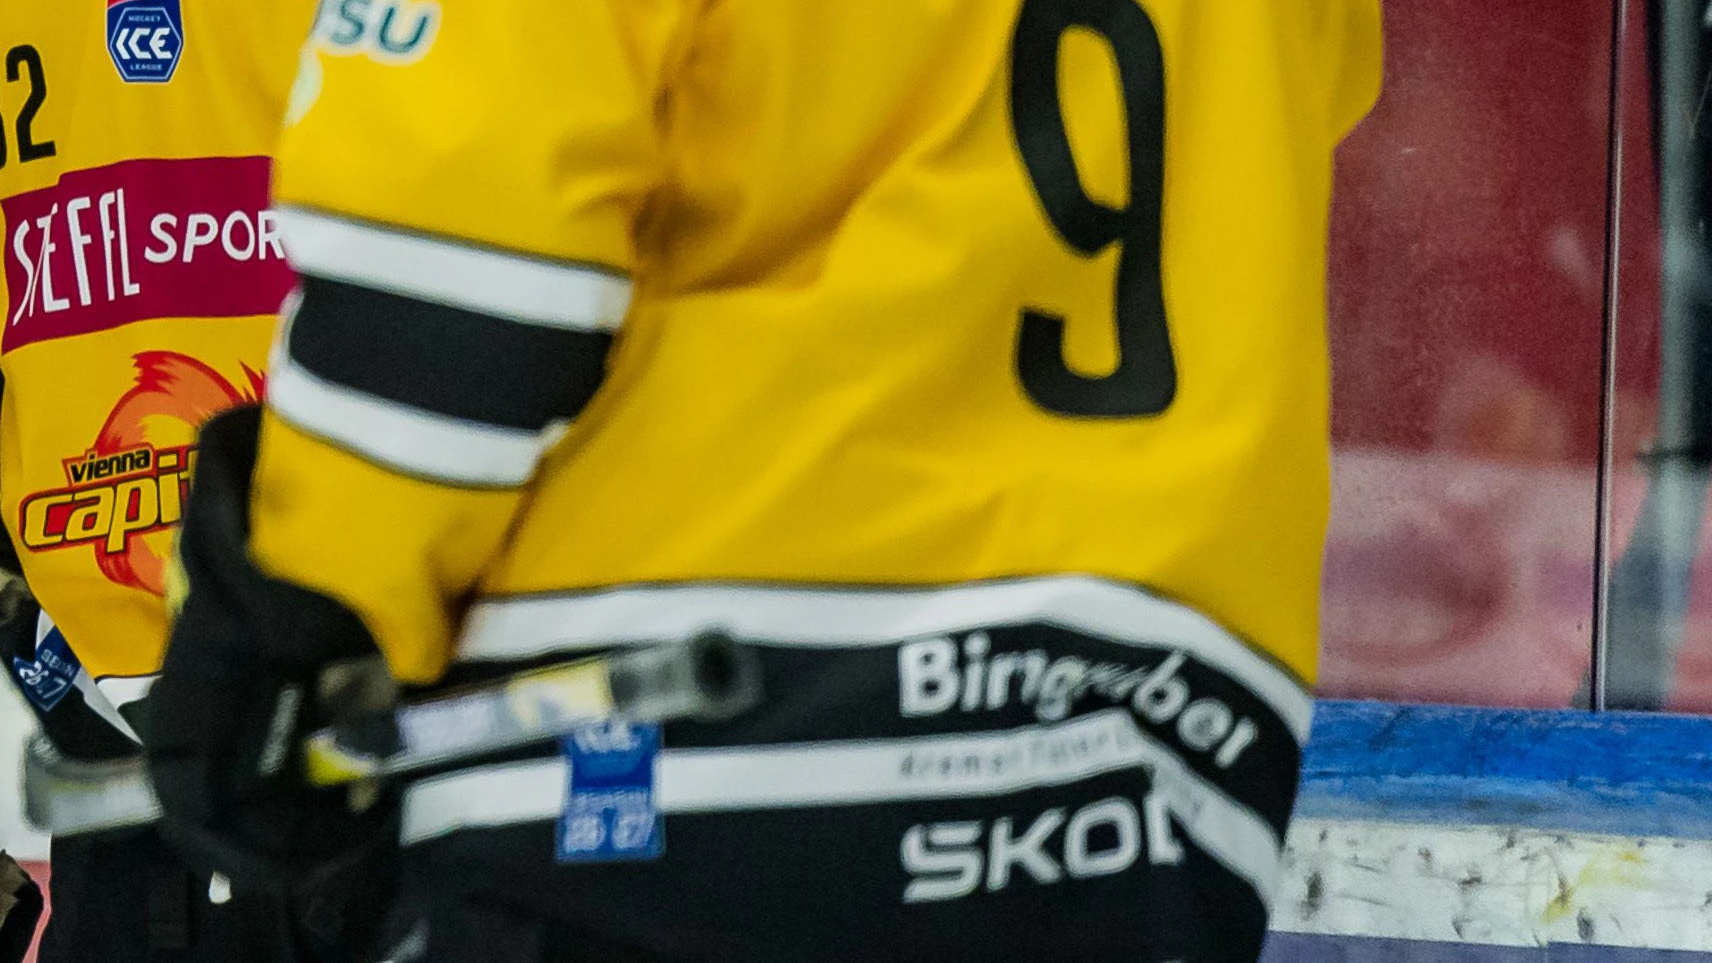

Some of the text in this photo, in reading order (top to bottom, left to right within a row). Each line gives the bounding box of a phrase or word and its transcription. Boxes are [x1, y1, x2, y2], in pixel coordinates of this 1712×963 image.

[115, 27, 173, 60] ICE
[12, 187, 140, 326] STEFFL
[144, 210, 286, 264] SPOR
[69, 448, 151, 485] vienna
[23, 450, 196, 554] capi
